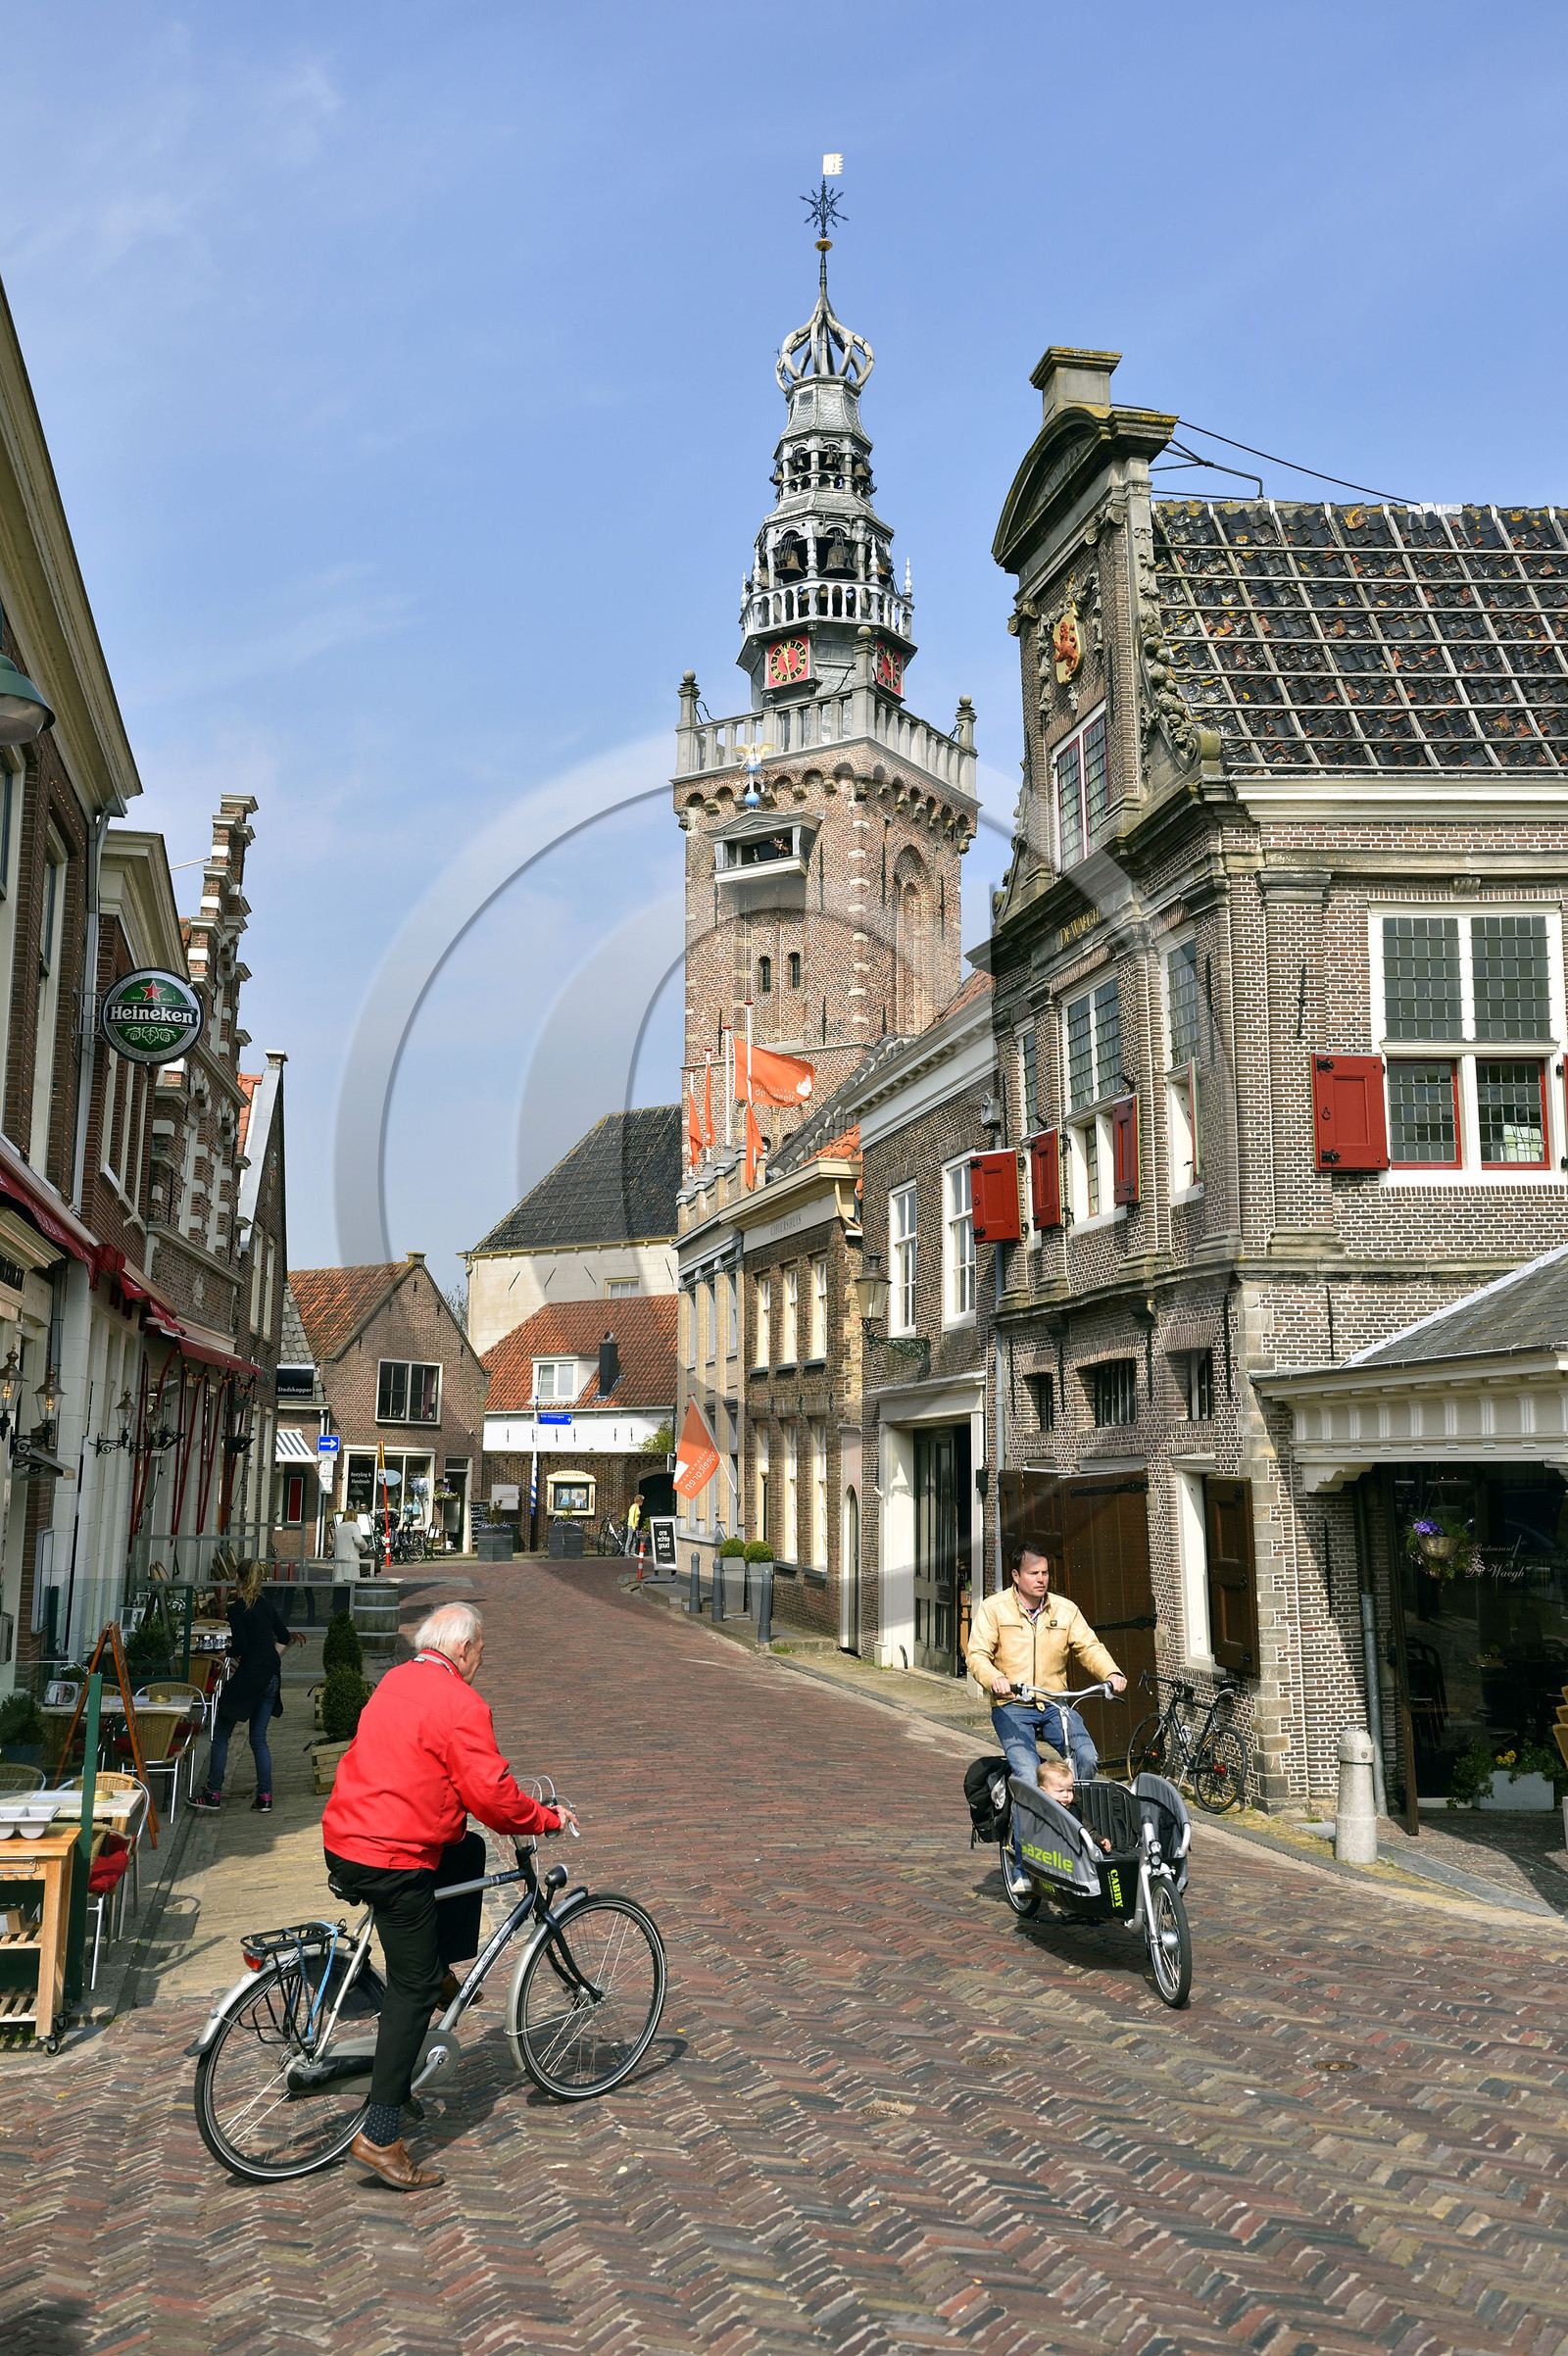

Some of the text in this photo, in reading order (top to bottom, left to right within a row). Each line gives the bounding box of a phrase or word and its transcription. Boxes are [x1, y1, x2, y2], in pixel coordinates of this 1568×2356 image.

[111, 1006, 194, 1024] Heineken
[1487, 1563, 1525, 1583] Waegh
[1110, 1869, 1124, 1907] CABBY
